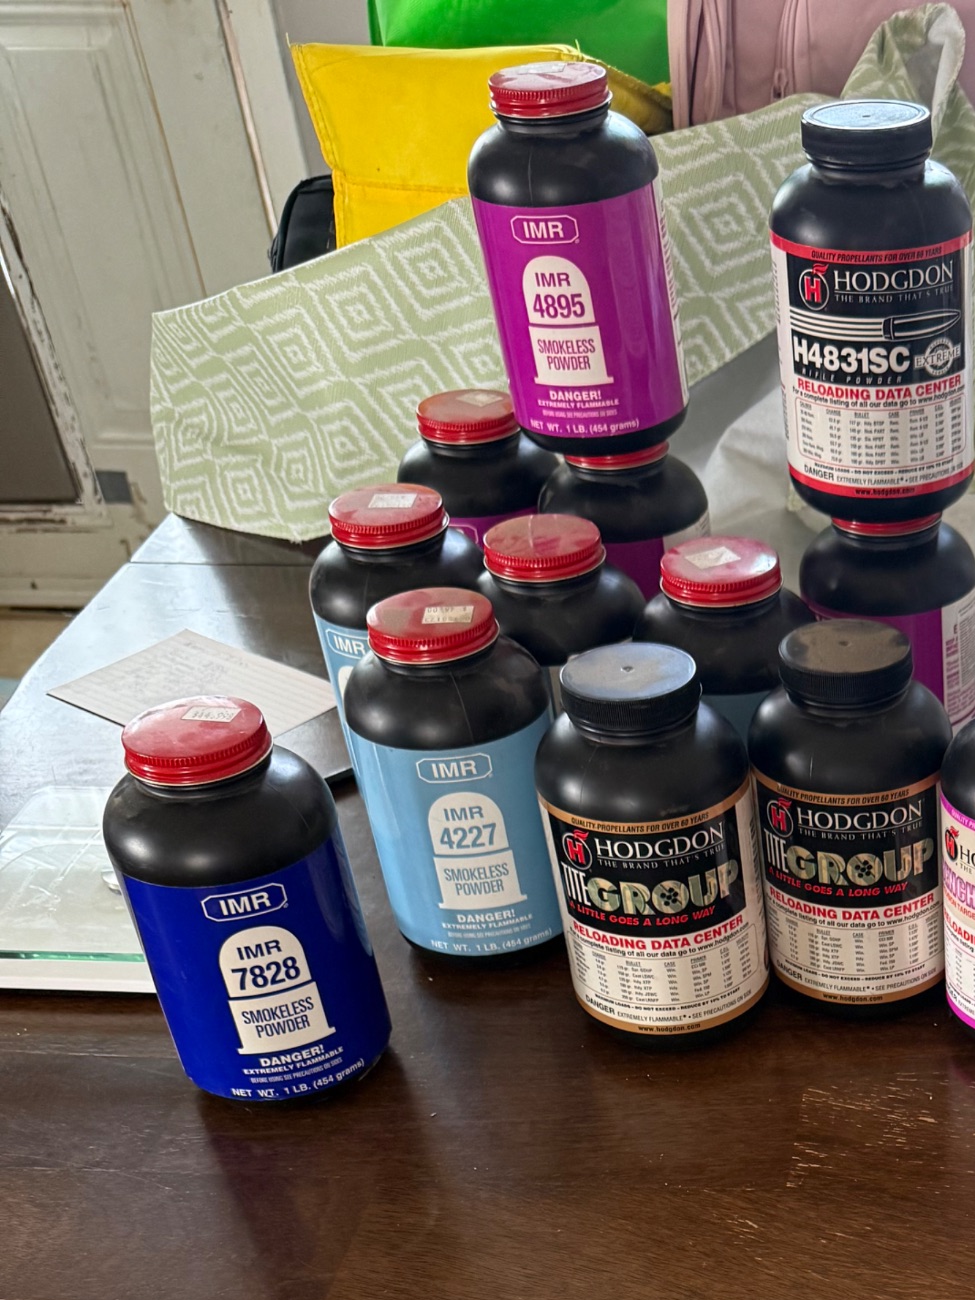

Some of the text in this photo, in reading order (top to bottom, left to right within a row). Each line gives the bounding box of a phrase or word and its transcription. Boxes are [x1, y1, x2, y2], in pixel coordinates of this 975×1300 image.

[523, 221, 564, 239] IMR
[535, 272, 571, 287] IMR
[834, 261, 953, 292] HODGDON
[533, 293, 585, 318] 4895
[537, 338, 595, 355] SMOKELESS
[793, 336, 911, 374] H4831SC
[547, 353, 591, 371] POWDER
[550, 389, 601, 401] DANGER!
[797, 374, 961, 401] RELOADING DATA CENTER
[538, 398, 619, 408] EXTREMELY FLAMMABLE
[530, 419, 543, 430] NET
[546, 422, 562, 433] WT.
[572, 423, 587, 434] LB.
[589, 422, 607, 435] (454
[610, 418, 639, 433] grams)
[431, 760, 477, 778] IMR
[443, 807, 484, 822] IMR
[797, 801, 922, 830] HODGDON
[440, 823, 498, 850] 4227
[595, 822, 724, 860] HODGDON
[444, 863, 509, 882] SMOKELESS
[455, 879, 504, 896] POWDER
[219, 891, 271, 917] IMR
[770, 887, 934, 920] RELOADING DATA CENTER
[457, 908, 516, 923] DANGER!
[577, 905, 605, 920] LITTLE
[609, 915, 639, 926] GOES
[656, 915, 688, 926] LONG
[692, 905, 715, 919] WAY
[573, 915, 743, 950] RELOADING DATA CENTER
[236, 939, 282, 961] IMR
[231, 956, 301, 991] 7828
[241, 996, 315, 1026] SMOKELESS
[255, 1015, 311, 1039] POWDER
[243, 1064, 293, 1075] EXTREMELY
[295, 1046, 343, 1068] FLAMMABLE
[260, 1044, 325, 1067] DANGER!
[232, 1087, 252, 1098] NET
[257, 1086, 279, 1098] WT.
[293, 1082, 311, 1094] LB.
[313, 1073, 334, 1091] (454
[336, 1057, 365, 1082] grams)
